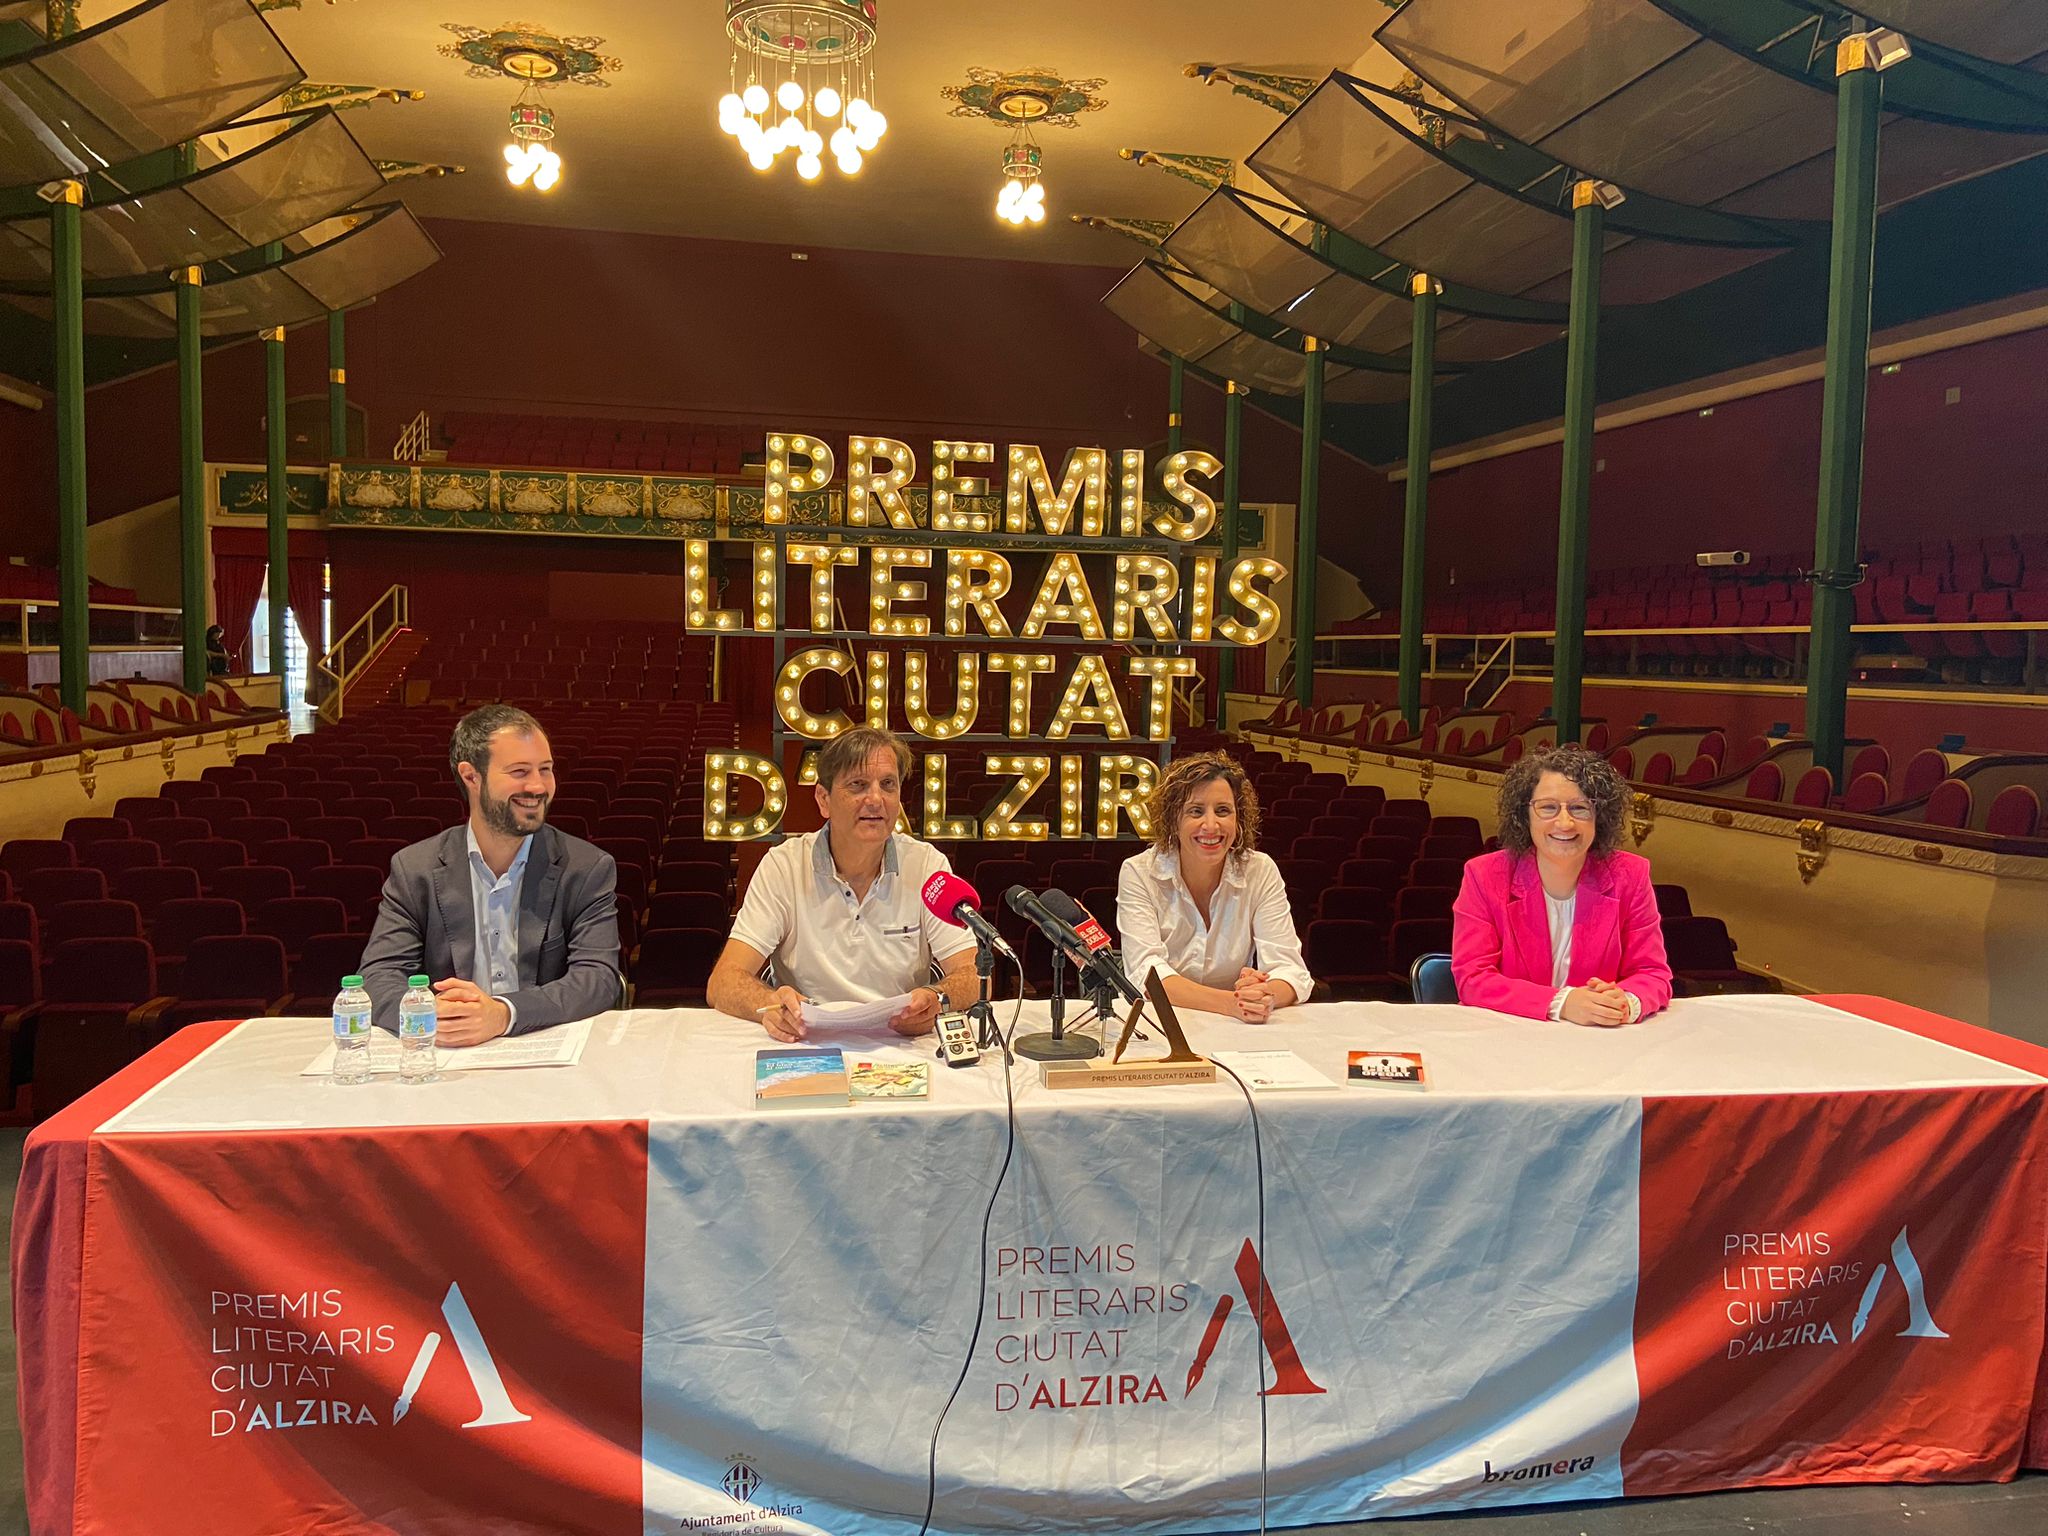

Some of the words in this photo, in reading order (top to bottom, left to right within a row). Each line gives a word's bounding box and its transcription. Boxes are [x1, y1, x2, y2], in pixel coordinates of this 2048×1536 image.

[764, 431, 1223, 541] PREMIS
[684, 538, 1289, 646] LITERARIS
[774, 645, 1196, 741] CIUTAT
[996, 1243, 1135, 1276] PREMIS
[1723, 1232, 1830, 1256] PREMIS
[1723, 1261, 1863, 1290] LITERARIS
[211, 1289, 342, 1319] PREMIS
[996, 1284, 1188, 1320] LITERARIS
[1726, 1297, 1820, 1325] CIUTAT
[211, 1324, 395, 1356] LITERARIS
[995, 1329, 1128, 1364] CIUTAT
[1727, 1321, 1838, 1360] D'ALZIRA
[211, 1363, 336, 1392] CIUTAT
[995, 1373, 1168, 1411] D'ALZIRA
[211, 1398, 378, 1437] D'ALZIRA
[1481, 1455, 1595, 1483] bromera
[681, 1510, 755, 1530] Ajuntament
[759, 1503, 803, 1521] d'Alzira
[741, 1527, 752, 1535] de
[753, 1524, 784, 1533] Cultura
